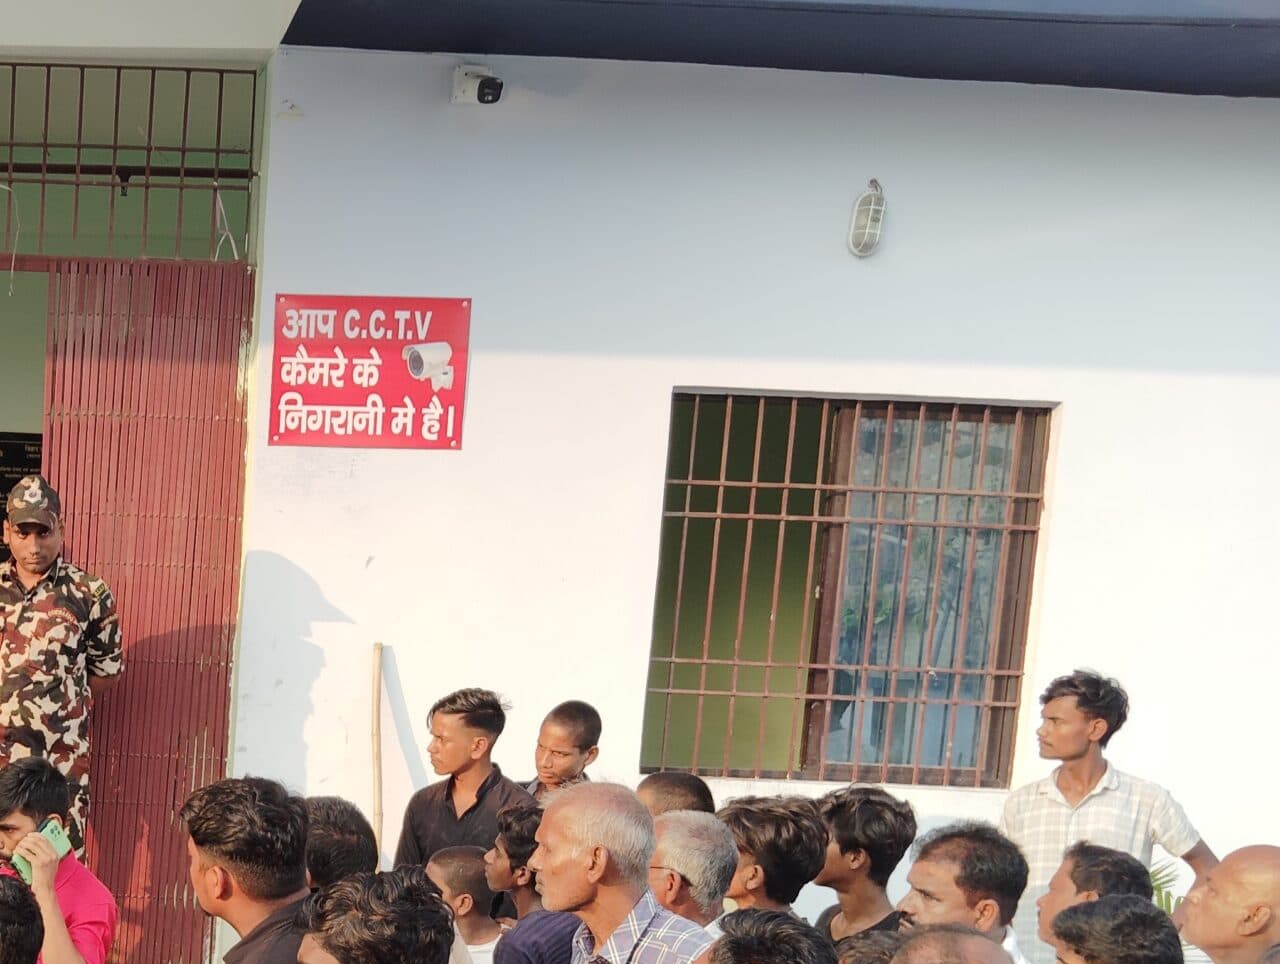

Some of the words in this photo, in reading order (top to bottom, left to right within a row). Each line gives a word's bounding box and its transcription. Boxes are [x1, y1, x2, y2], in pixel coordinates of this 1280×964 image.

[282, 308, 337, 339] आप
[343, 308, 433, 340] C.C.T.V
[280, 343, 348, 388] कैमरे
[352, 347, 383, 388] के
[278, 391, 386, 436] निगरानी
[391, 395, 416, 437] मे
